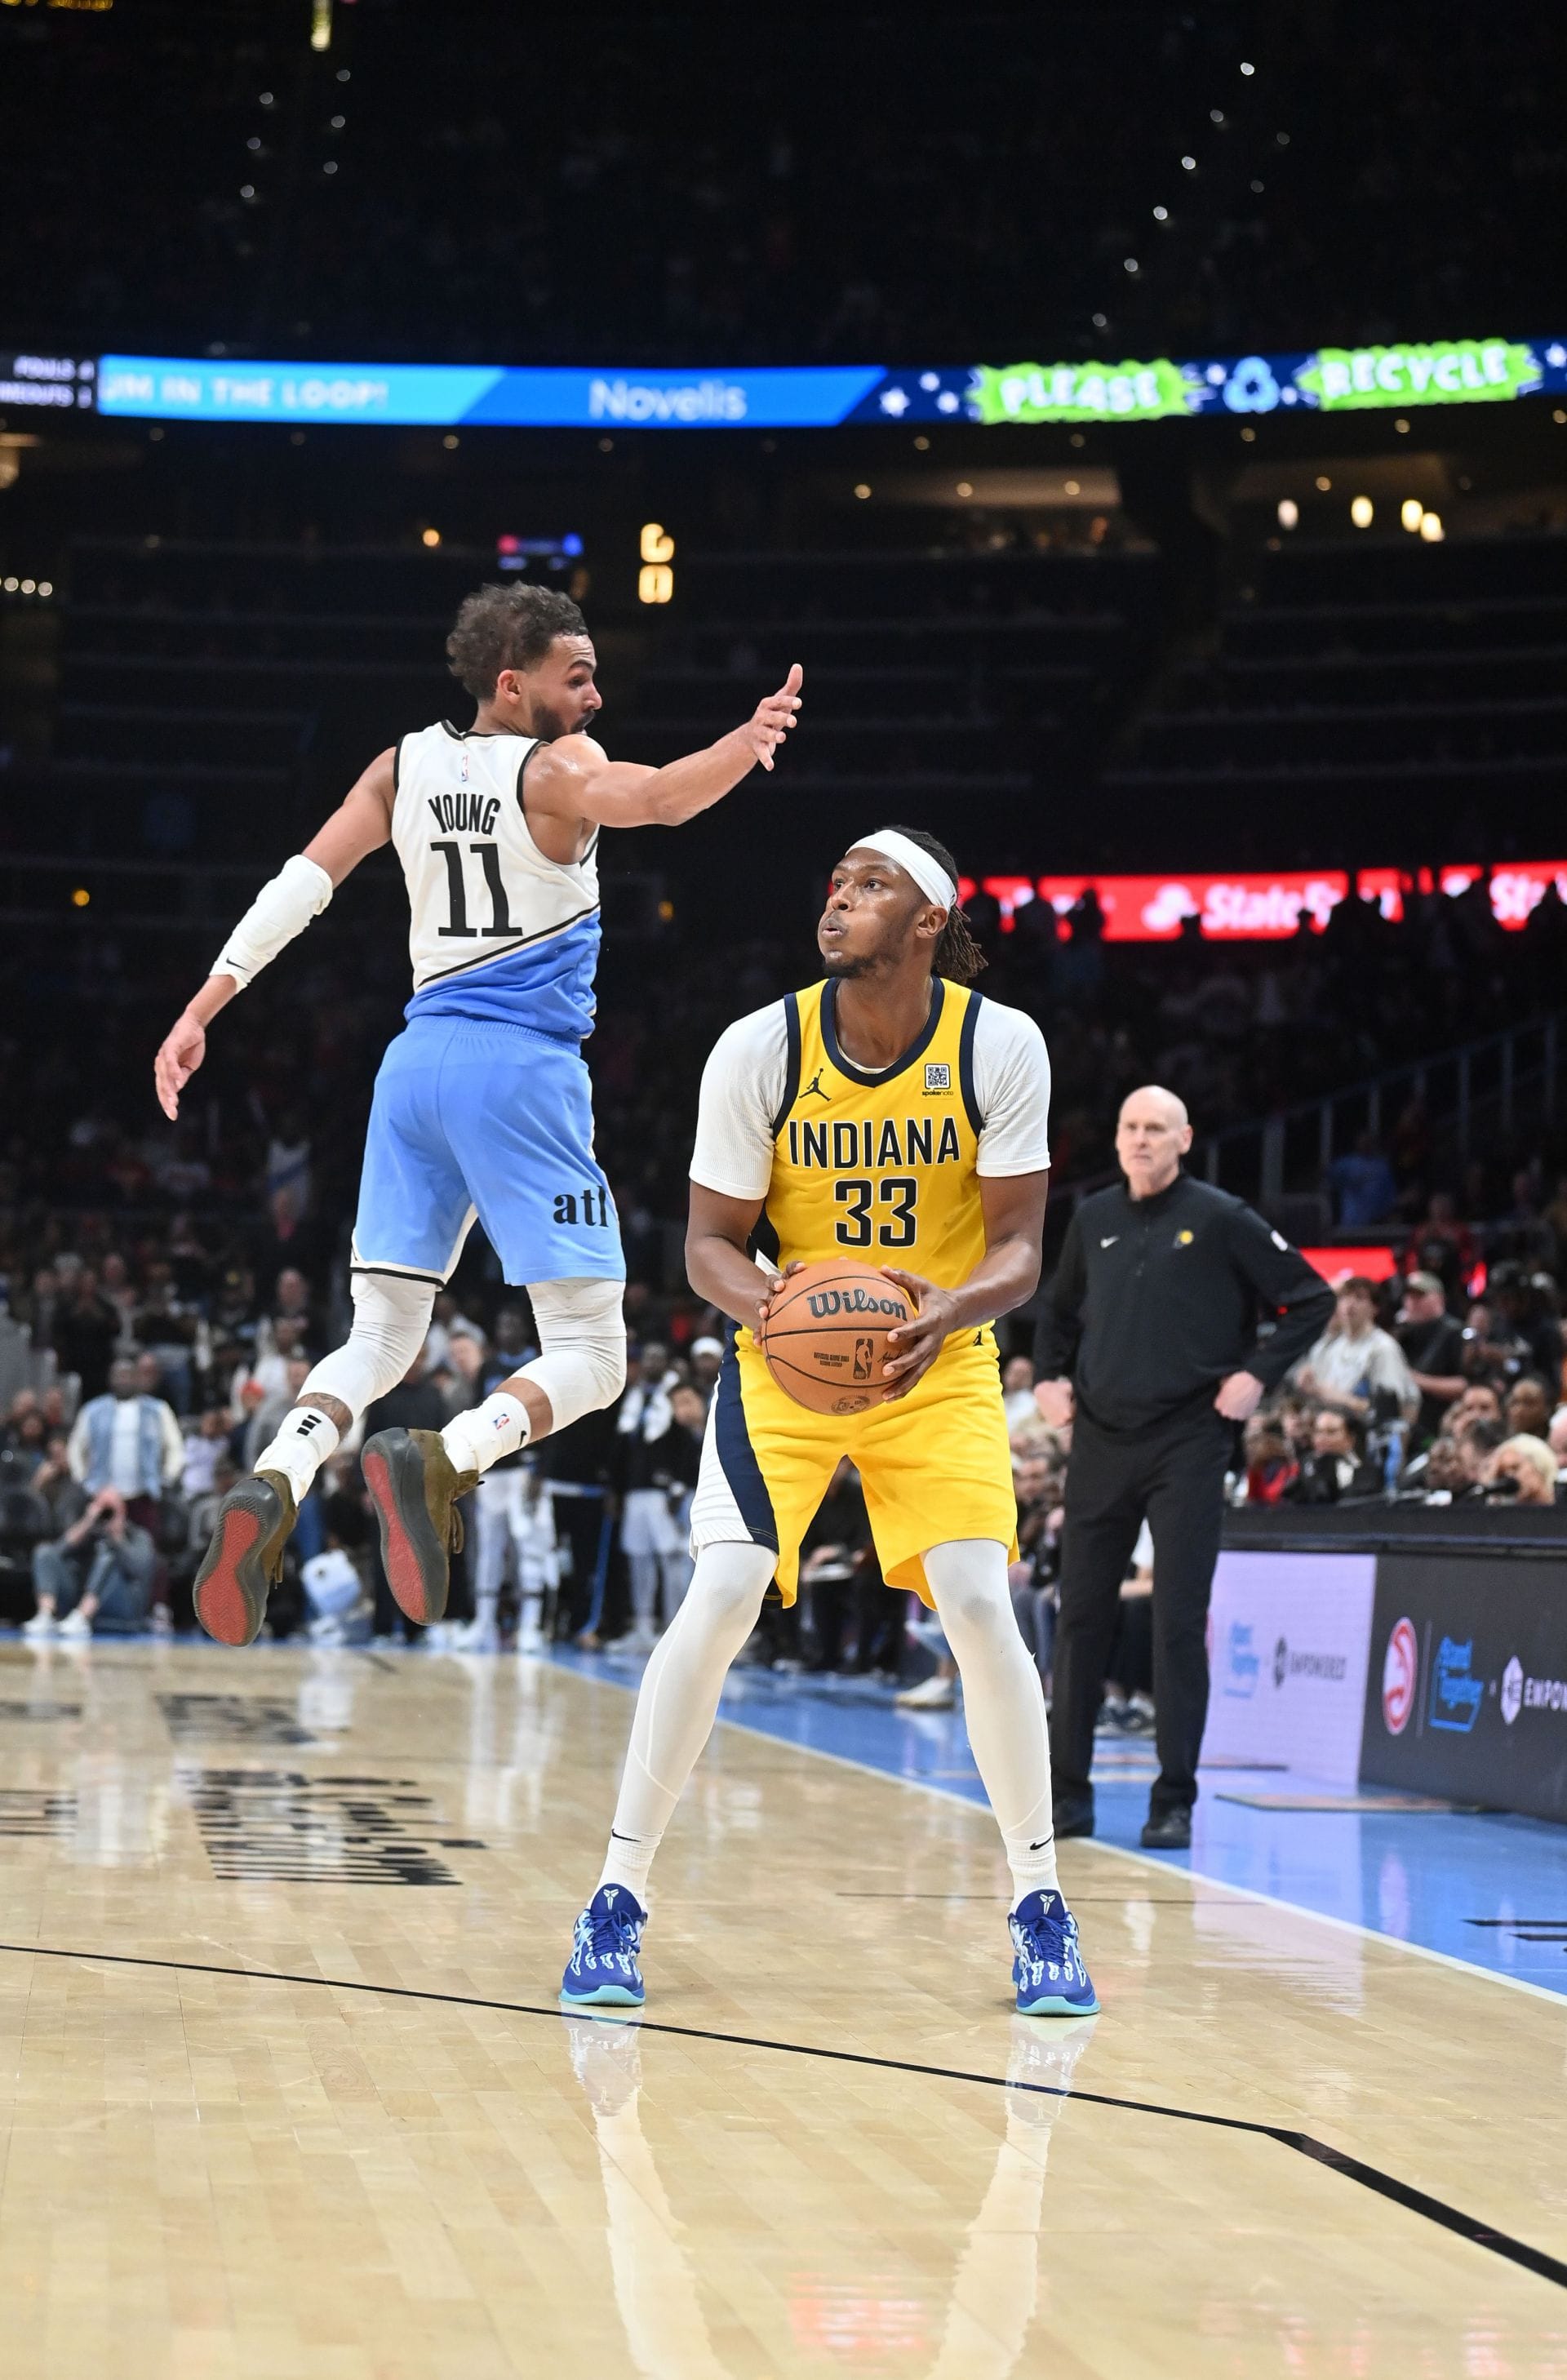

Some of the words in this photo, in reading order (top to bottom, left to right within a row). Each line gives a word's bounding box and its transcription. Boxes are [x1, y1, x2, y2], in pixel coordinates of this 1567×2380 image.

[212, 376, 274, 408] THE
[1001, 368, 1160, 414] PLEASE
[1322, 344, 1509, 398] RECYCLE
[588, 378, 748, 422] Novelis
[428, 793, 501, 836] YOUNG
[429, 841, 523, 938] 11
[1202, 881, 1301, 929] State
[788, 1117, 961, 1170] INDIANA
[553, 1185, 609, 1228] atl
[834, 1177, 919, 1248] 33
[807, 1289, 908, 1321] Wilson
